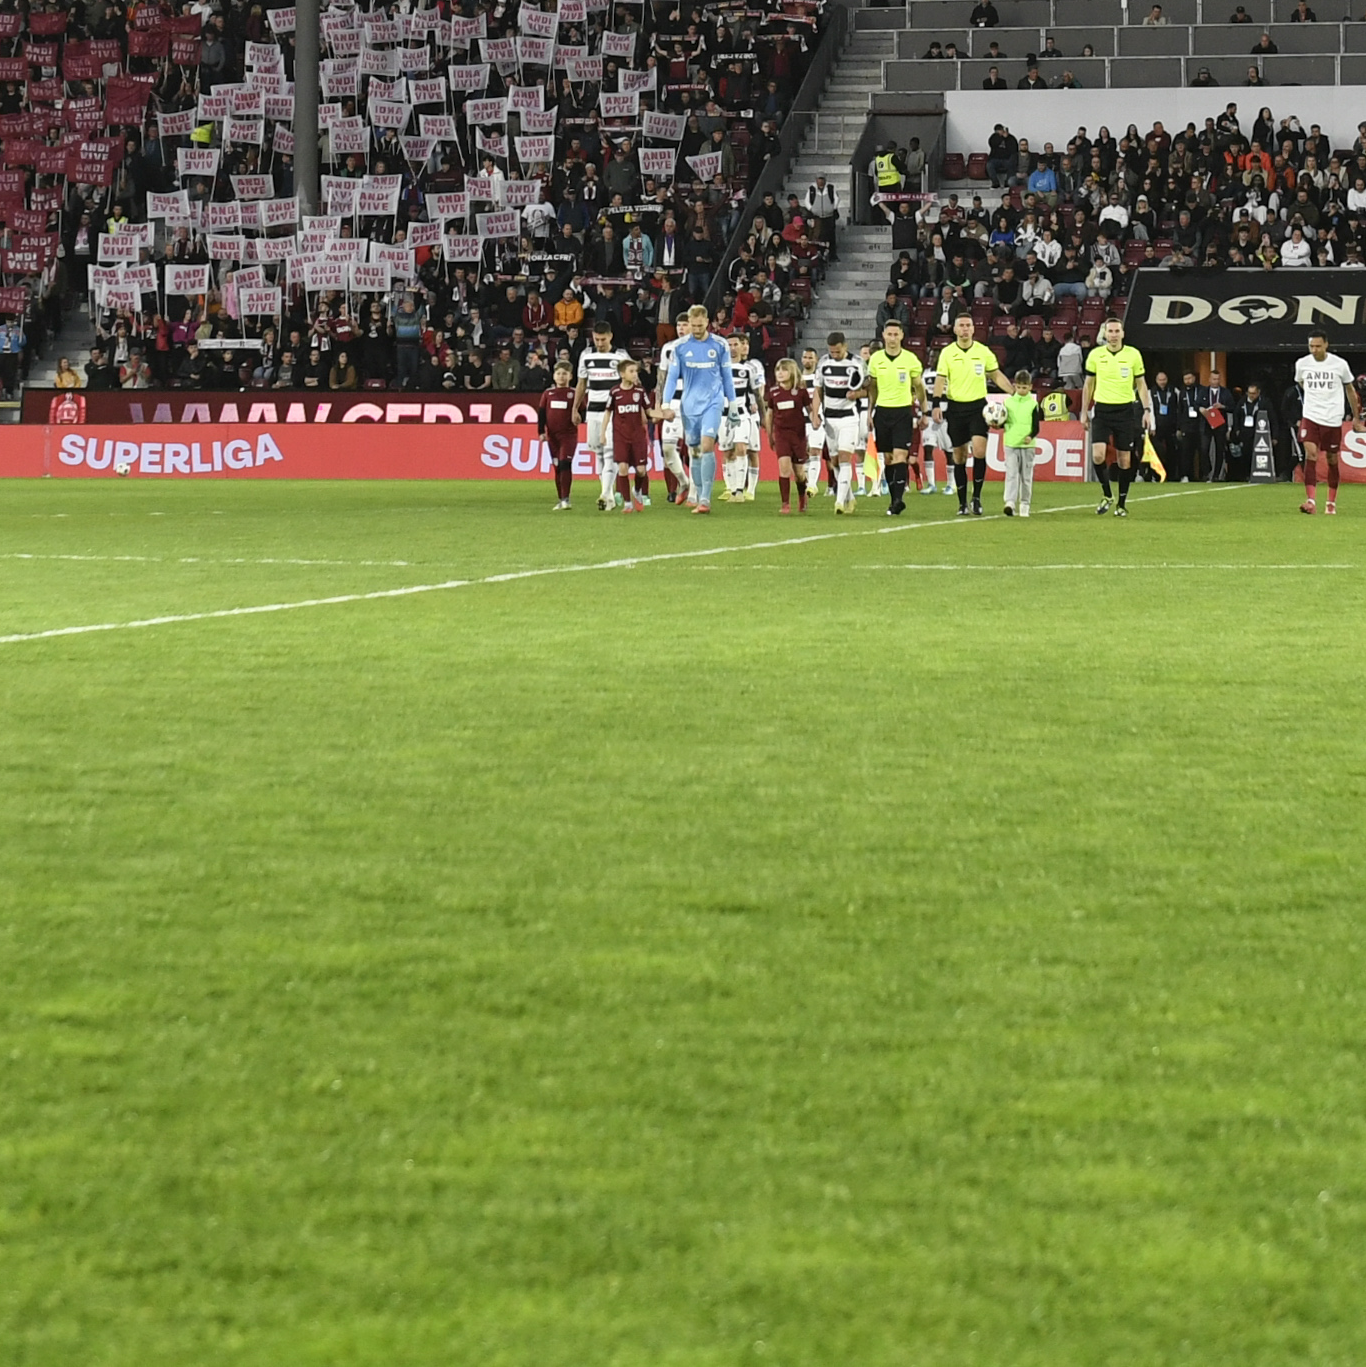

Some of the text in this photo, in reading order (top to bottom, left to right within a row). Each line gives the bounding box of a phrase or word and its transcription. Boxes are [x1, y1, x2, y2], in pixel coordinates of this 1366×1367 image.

[520, 40, 545, 49] ANDI
[521, 50, 545, 58] VIVE
[328, 76, 355, 85] ANDI
[328, 85, 355, 94] VIVE
[415, 81, 441, 92] ANDI
[235, 92, 260, 101] ANDI
[415, 90, 443, 100] VIVE
[235, 100, 260, 110] VIVE
[605, 96, 632, 105] ANDI
[474, 102, 501, 111] ANDI
[605, 105, 632, 114] VIVE
[163, 114, 190, 124] ANDI
[474, 111, 501, 119] VIVE
[163, 123, 191, 133] VIVE
[231, 122, 258, 132] ANDI
[230, 131, 257, 141] VIVE
[335, 134, 363, 142] ANDI
[336, 142, 363, 150] VIVE
[520, 139, 548, 148] ANDI
[521, 148, 548, 157] VIVE
[643, 151, 671, 160] ANDI
[644, 160, 672, 170] VIVE
[237, 175, 265, 185] ANDI
[238, 184, 266, 194] VIVE
[360, 191, 389, 201] ANDI
[438, 193, 465, 203] ANDI
[360, 202, 389, 211] VIVE
[438, 203, 465, 213] VIVE
[413, 223, 440, 234] ANDI
[103, 237, 132, 245] ANDI
[413, 233, 440, 244] VIVE
[212, 241, 240, 250] ANDI
[103, 247, 132, 256] VIVE
[212, 251, 240, 259] VIVE
[174, 268, 205, 279] ANDI
[311, 265, 341, 275] ANDI
[355, 266, 384, 276] ANDI
[175, 278, 205, 290] VIVE
[311, 275, 341, 285] VIVE
[355, 276, 384, 287] VIVE
[107, 290, 133, 300] ANDI
[248, 292, 275, 302] ANDI
[106, 298, 135, 312] VIVE
[248, 303, 275, 312] VIVE
[685, 361, 716, 369] SUPERBET
[1306, 371, 1335, 380] ANDI
[58, 432, 283, 474] SUPERLIGA
